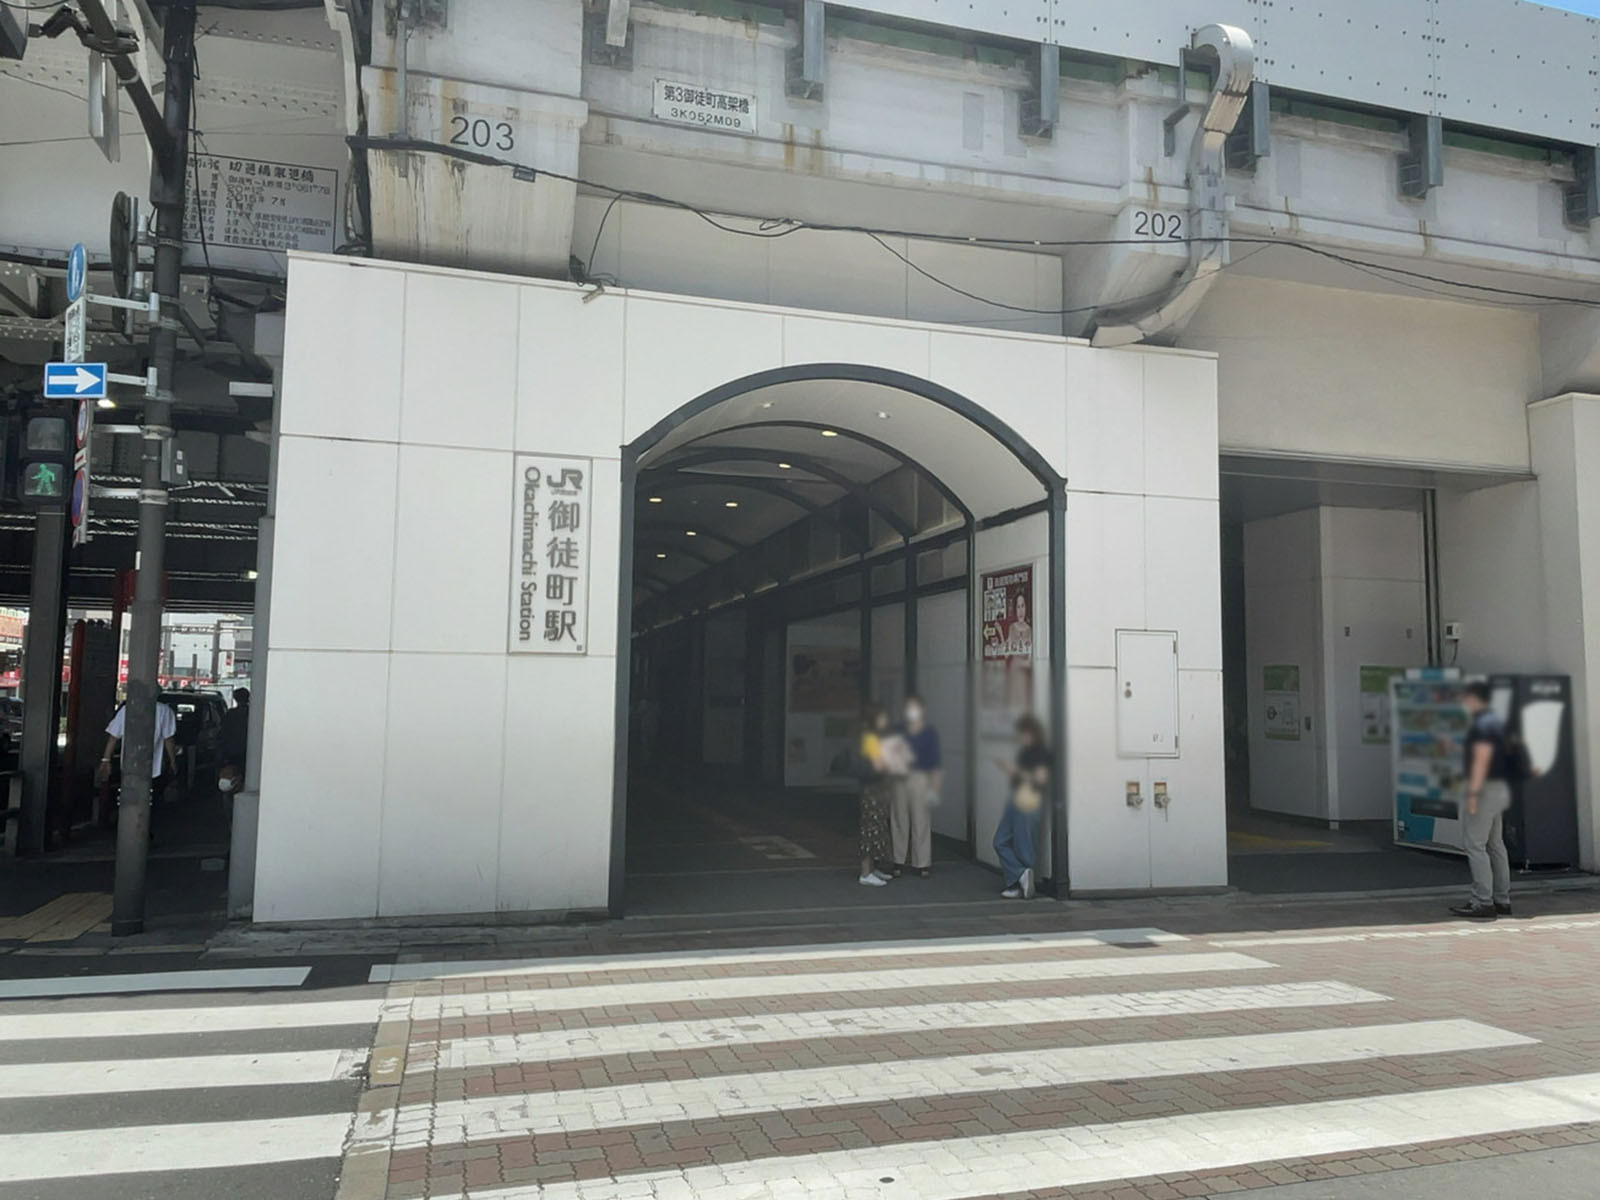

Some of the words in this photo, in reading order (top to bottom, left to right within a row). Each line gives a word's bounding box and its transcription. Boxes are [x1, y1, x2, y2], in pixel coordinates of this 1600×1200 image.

[450, 116, 514, 151] 203
[670, 107, 742, 128] 3K052M09
[1135, 211, 1182, 239] 202
[546, 468, 583, 490] JR
[522, 466, 541, 576] Okachimachi
[544, 500, 580, 642] 御徒町駅
[519, 581, 538, 641] Station
